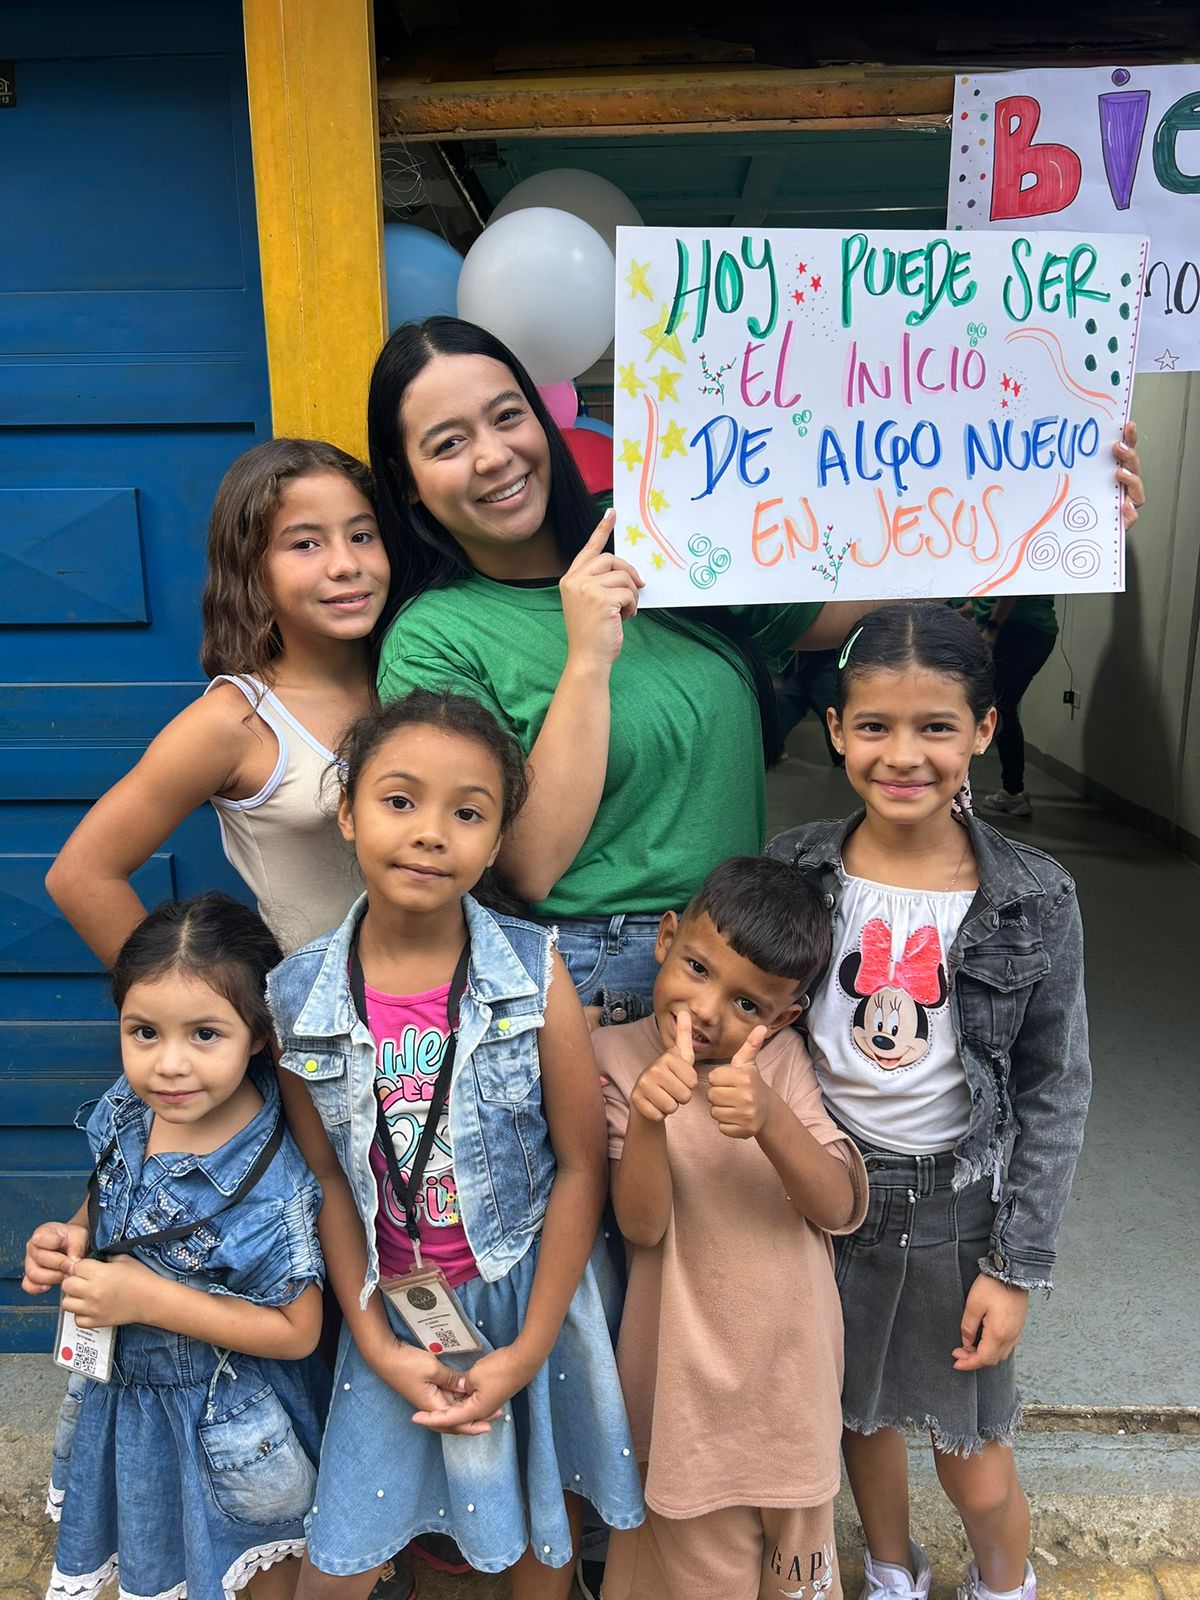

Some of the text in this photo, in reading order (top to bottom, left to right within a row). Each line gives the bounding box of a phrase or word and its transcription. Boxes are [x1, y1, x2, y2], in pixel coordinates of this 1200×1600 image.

[664, 234, 1111, 342] HOY PUEDE SER
[740, 320, 987, 408] EL INICIO
[690, 415, 1099, 501] DE ALGO NUEVO
[752, 485, 1005, 569] EN JESUS
[770, 1545, 822, 1582] GAP
